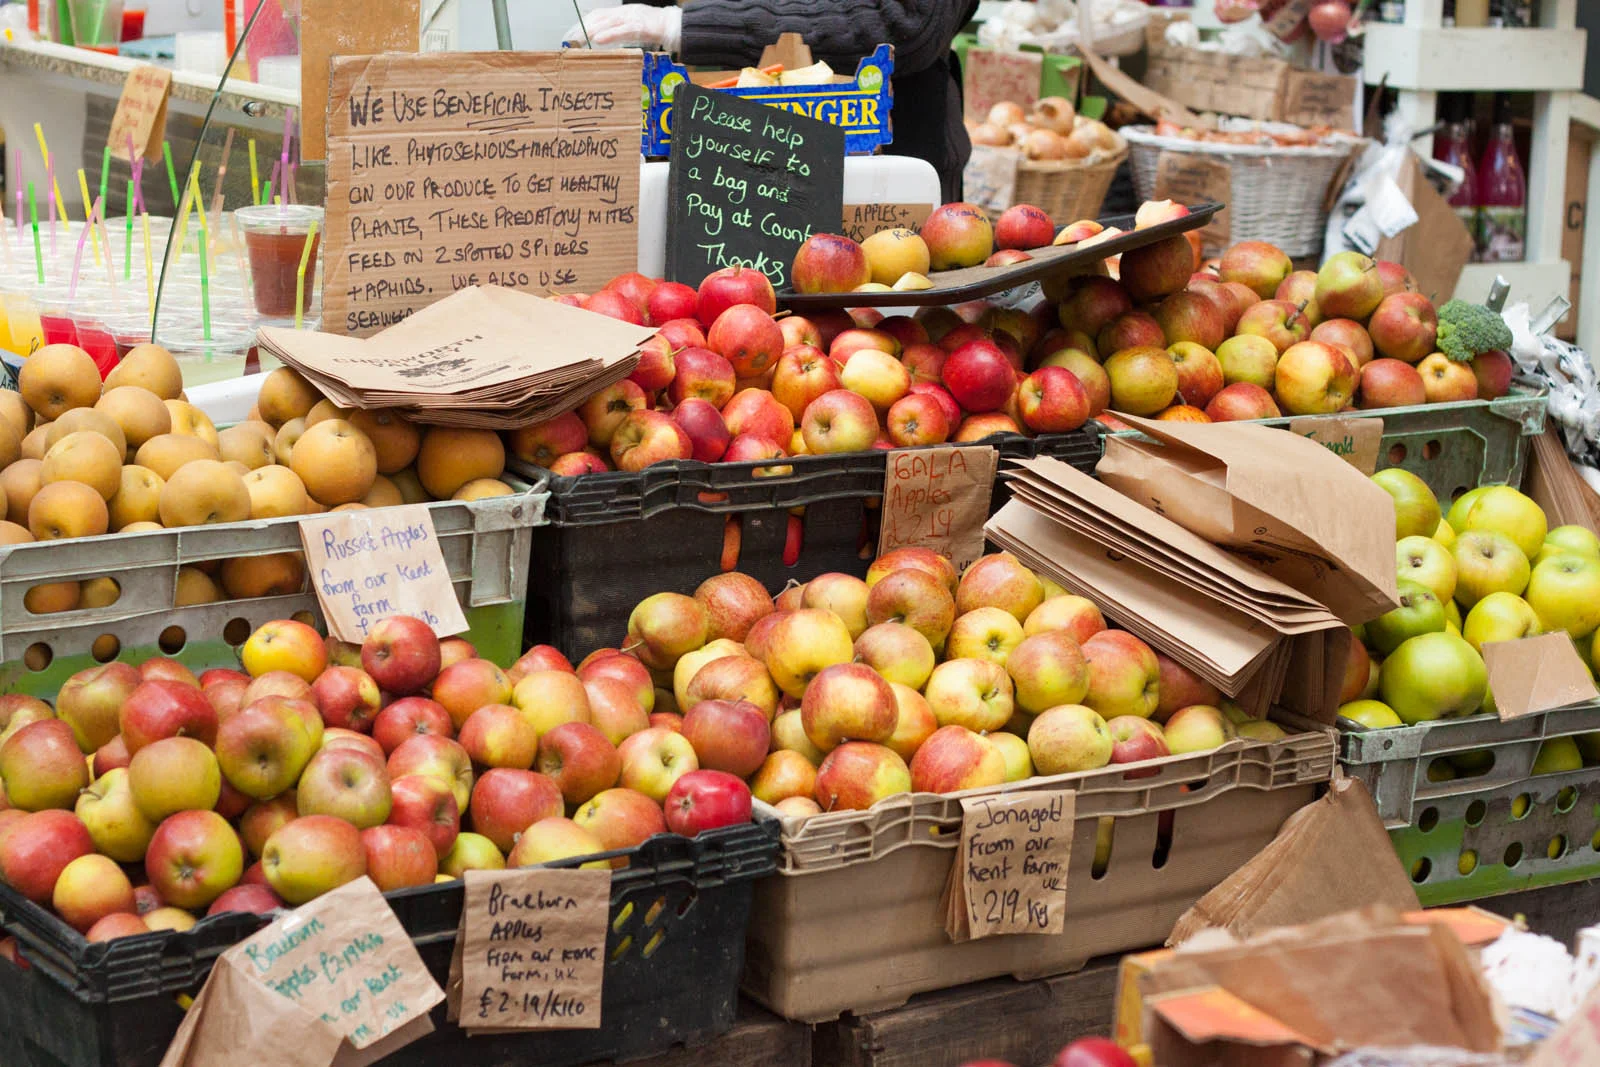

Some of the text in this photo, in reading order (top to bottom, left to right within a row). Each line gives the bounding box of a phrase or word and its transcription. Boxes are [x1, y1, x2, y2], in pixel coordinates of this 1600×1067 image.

[860, 71, 881, 91] bio
[350, 86, 614, 127] WE USE BENEFICIAL INSECTS
[762, 114, 804, 150] help
[786, 154, 811, 177] to
[349, 173, 621, 204] ON OUR PRODUCE TO GET HEALTHY
[688, 167, 702, 181] a
[712, 165, 747, 204] bag
[351, 216, 424, 242] PLANTS,
[428, 208, 489, 234] THESE
[588, 206, 635, 226] MITES
[686, 192, 724, 237] Pay
[731, 211, 753, 228] at
[349, 238, 589, 273] FEED ON 2 SPOTTED SPIDERS
[451, 273, 480, 290] WE
[488, 270, 529, 289] ALSO
[539, 270, 578, 289] USE
[894, 450, 967, 480] GALA
[891, 483, 952, 514] Apples
[381, 522, 429, 551] Apples
[320, 568, 357, 597] from
[364, 573, 389, 590] our
[352, 592, 396, 617] farm
[972, 795, 1063, 833] Jonagold
[1025, 836, 1055, 852] our
[488, 882, 577, 917] Braeburn
[554, 967, 579, 981] UK
